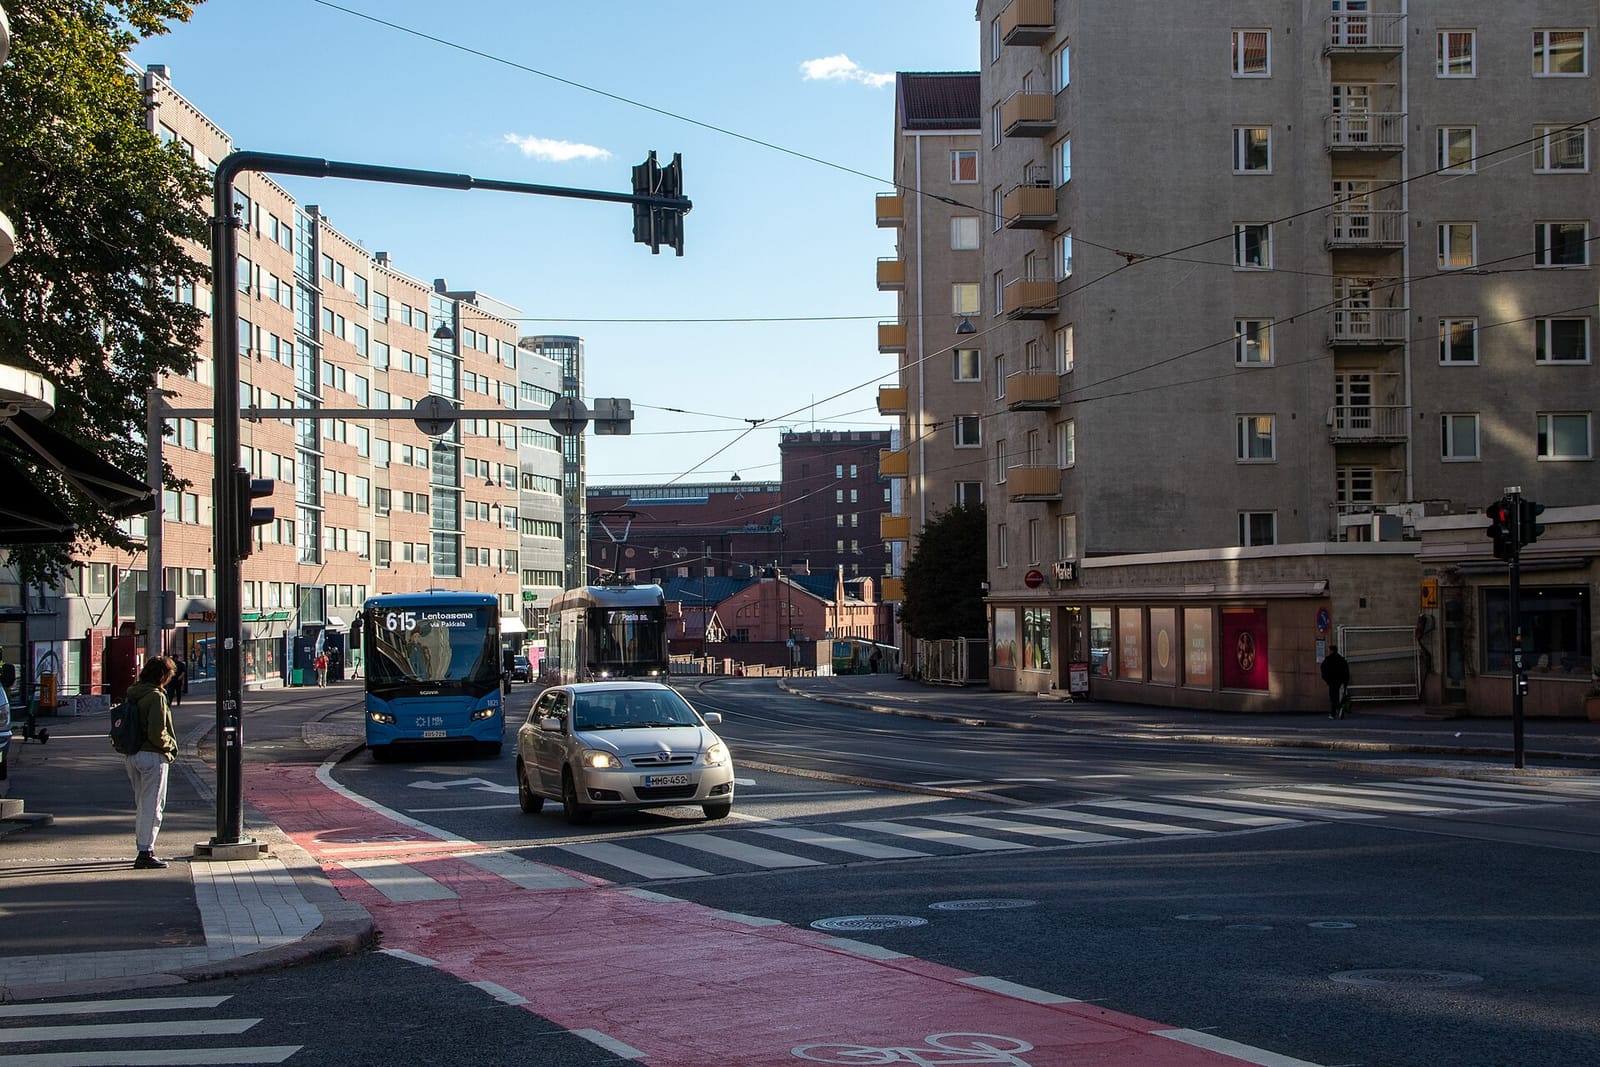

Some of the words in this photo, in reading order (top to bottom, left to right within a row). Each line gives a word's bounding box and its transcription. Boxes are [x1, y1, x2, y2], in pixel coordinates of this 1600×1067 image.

[386, 611, 417, 631] 615
[422, 612, 473, 620] Lentoasema
[607, 611, 616, 624] 7
